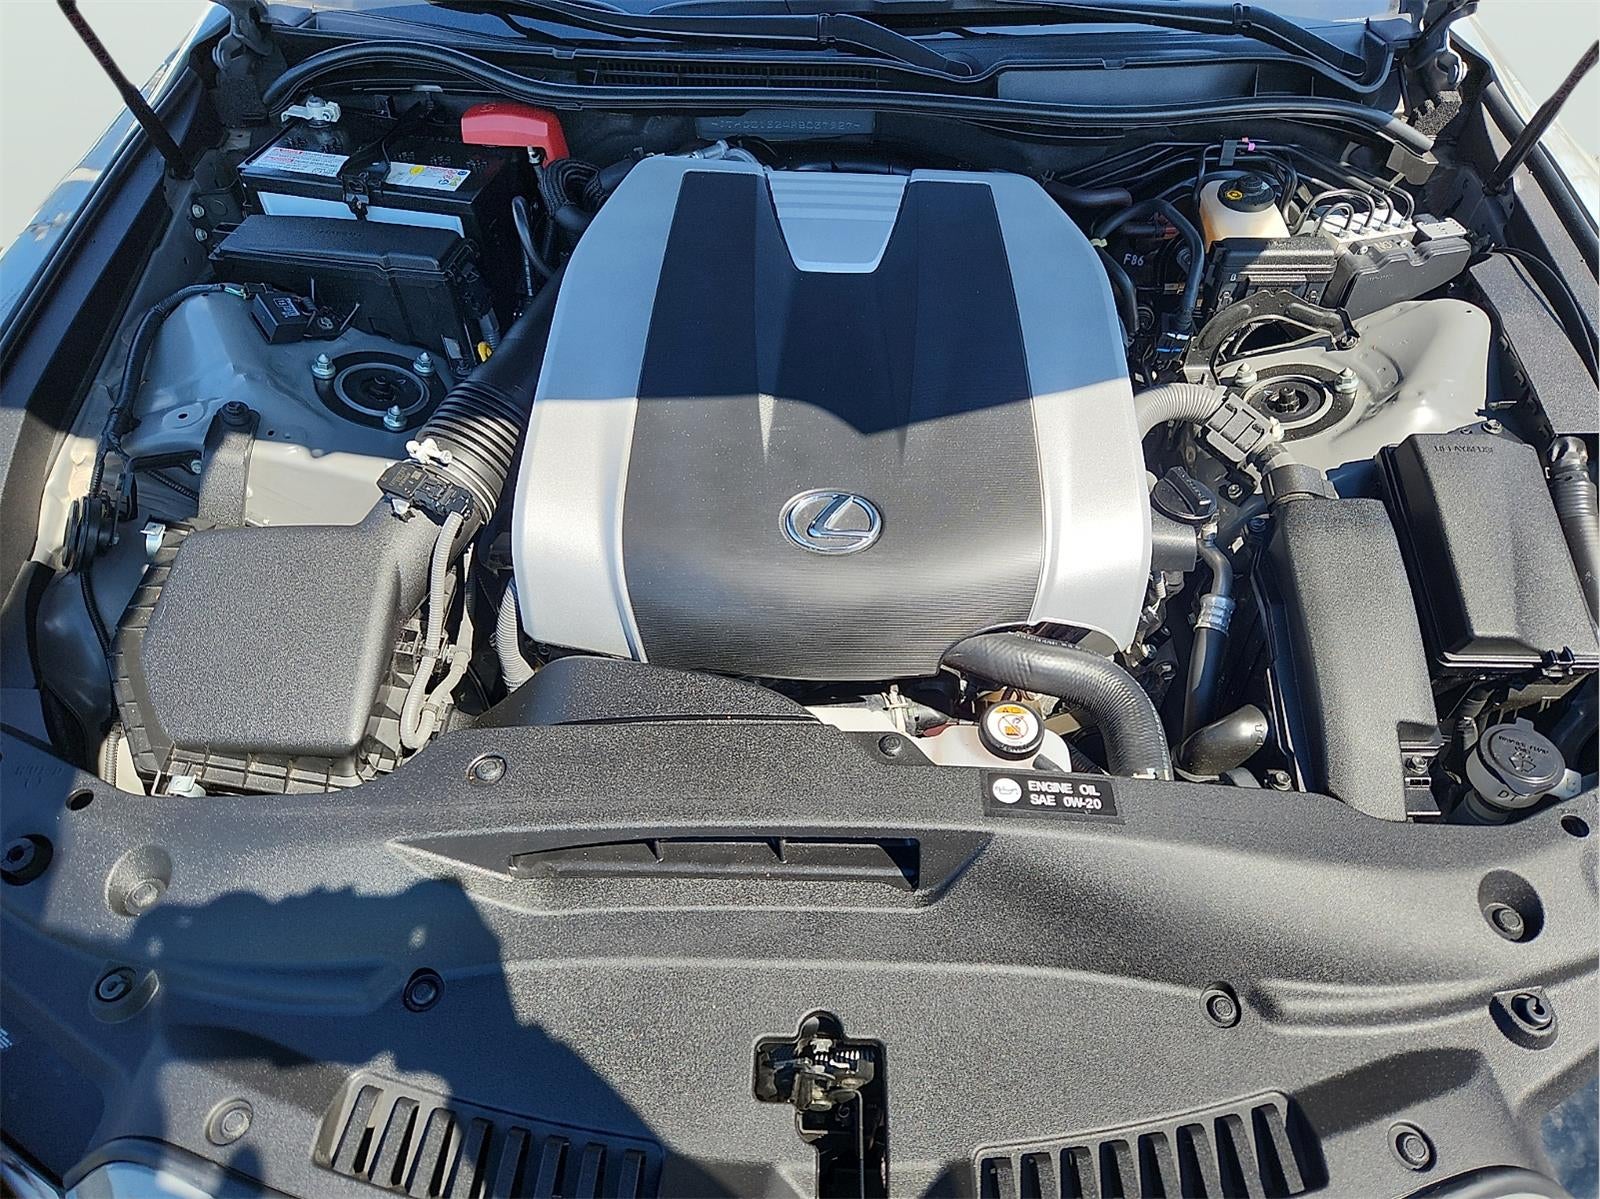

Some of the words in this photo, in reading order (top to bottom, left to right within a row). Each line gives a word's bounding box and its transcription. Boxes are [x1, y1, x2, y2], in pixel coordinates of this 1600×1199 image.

[1123, 253, 1144, 266] F86
[1028, 780, 1073, 794] ENGINE
[1079, 784, 1101, 796] OIL
[1030, 794, 1056, 806] SAE
[1063, 797, 1102, 809] 0W-20
